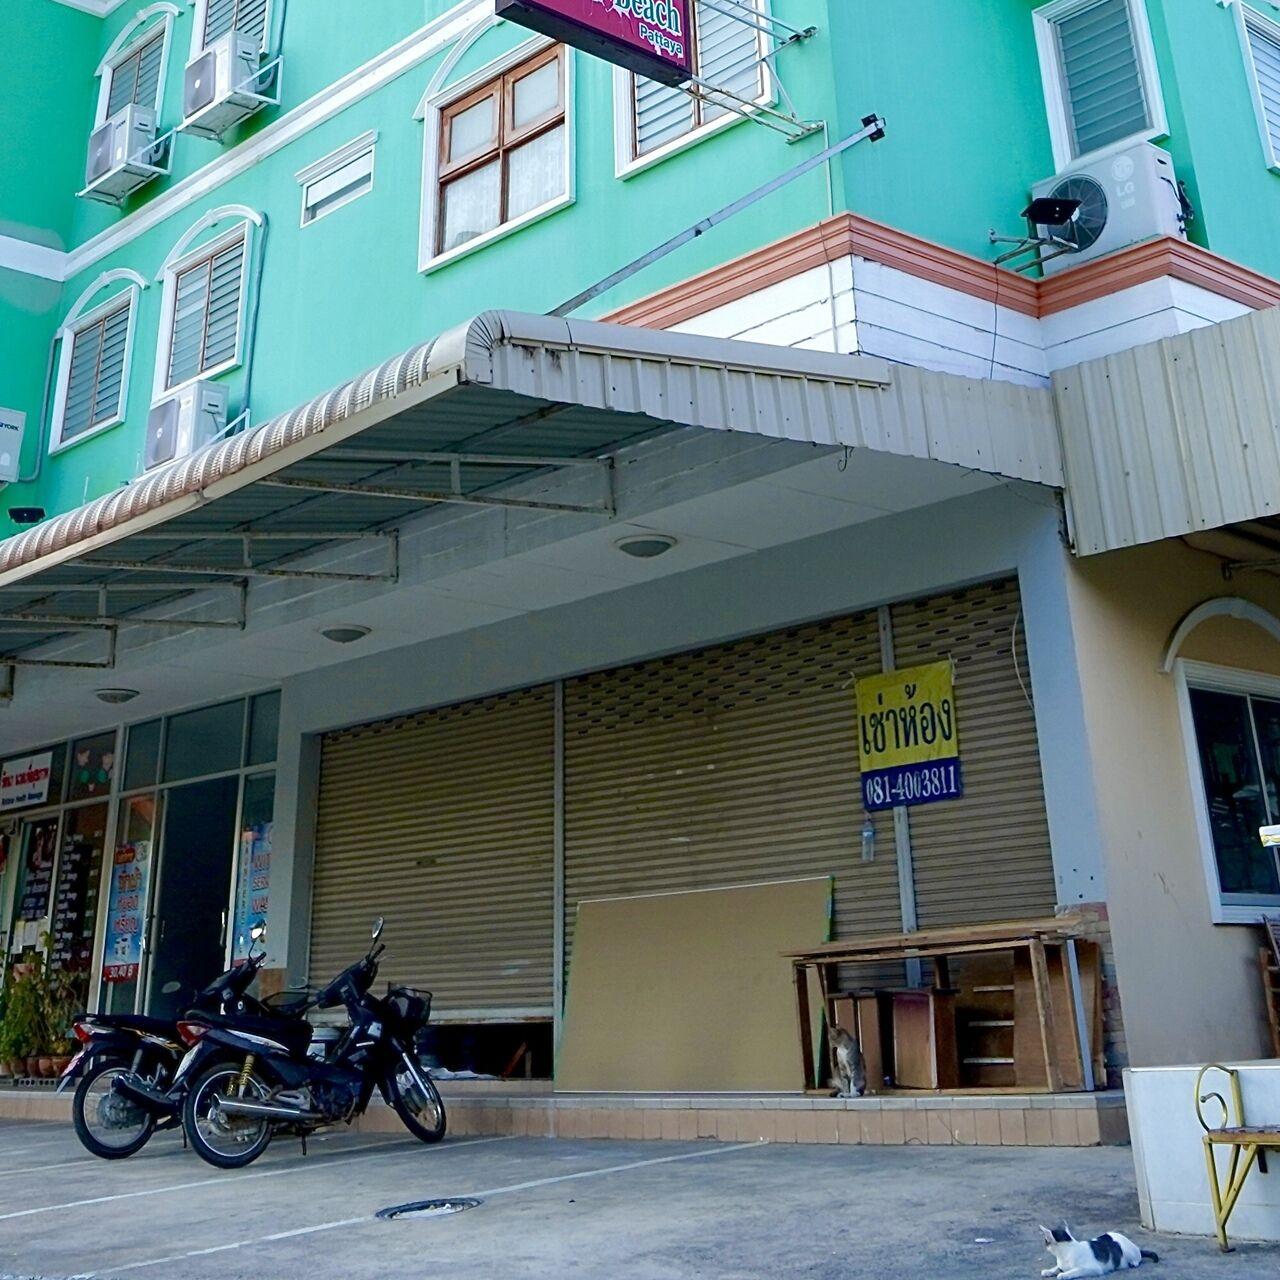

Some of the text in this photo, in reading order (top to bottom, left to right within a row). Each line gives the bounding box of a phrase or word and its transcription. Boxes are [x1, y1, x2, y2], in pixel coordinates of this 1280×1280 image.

[638, 23, 684, 59] Pattaya
[860, 683, 954, 755] เช่าห้อง
[865, 764, 958, 805] 081-4003811
